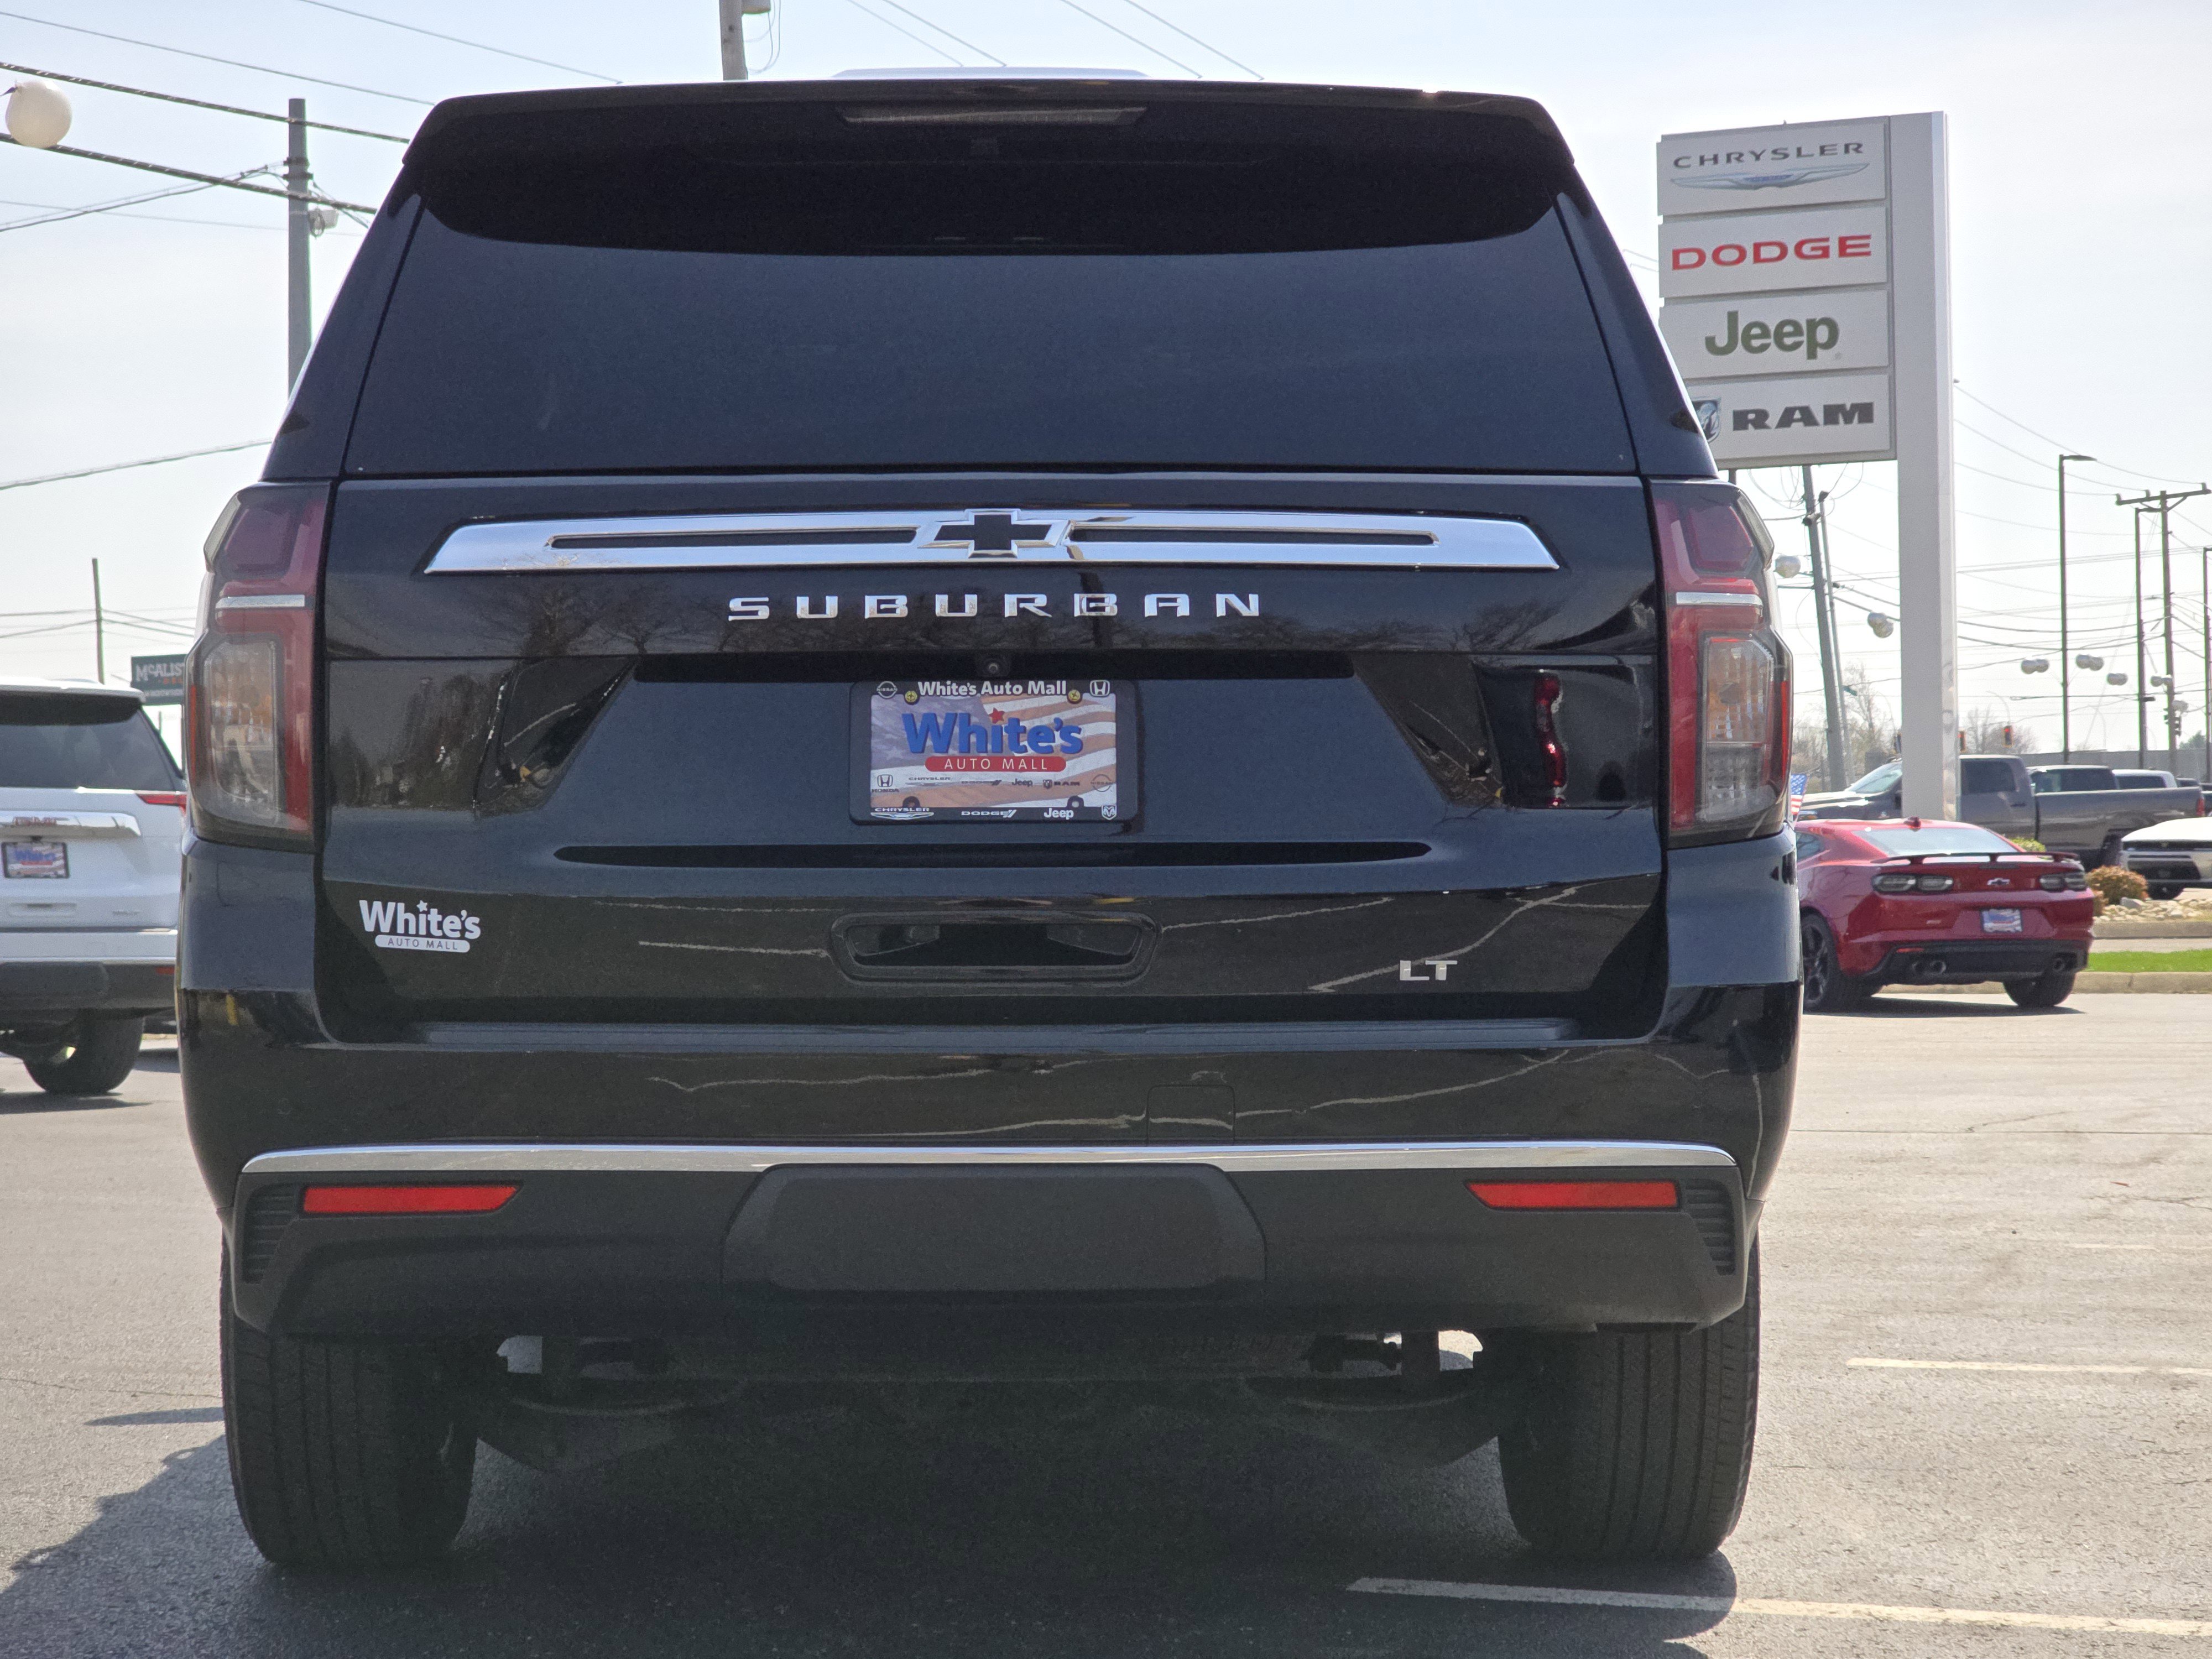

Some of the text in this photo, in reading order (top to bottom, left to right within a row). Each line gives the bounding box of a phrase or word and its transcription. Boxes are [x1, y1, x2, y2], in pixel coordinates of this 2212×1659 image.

[1673, 142, 1864, 169] CHRYSLER
[1671, 234, 1872, 270] DODGE
[1704, 310, 1840, 361] Jeep
[1732, 401, 1875, 431] RAM
[728, 593, 1260, 622] SUBURBAN
[917, 680, 1067, 696] White's Auto Mall
[901, 708, 1084, 754] White's
[944, 758, 1047, 770] AUTO MALL
[1011, 778, 1033, 787] Jeep
[1044, 807, 1074, 820] Jeep
[359, 899, 481, 939] White's
[388, 937, 458, 950] AUTO MALL
[1400, 959, 1458, 981] LT
